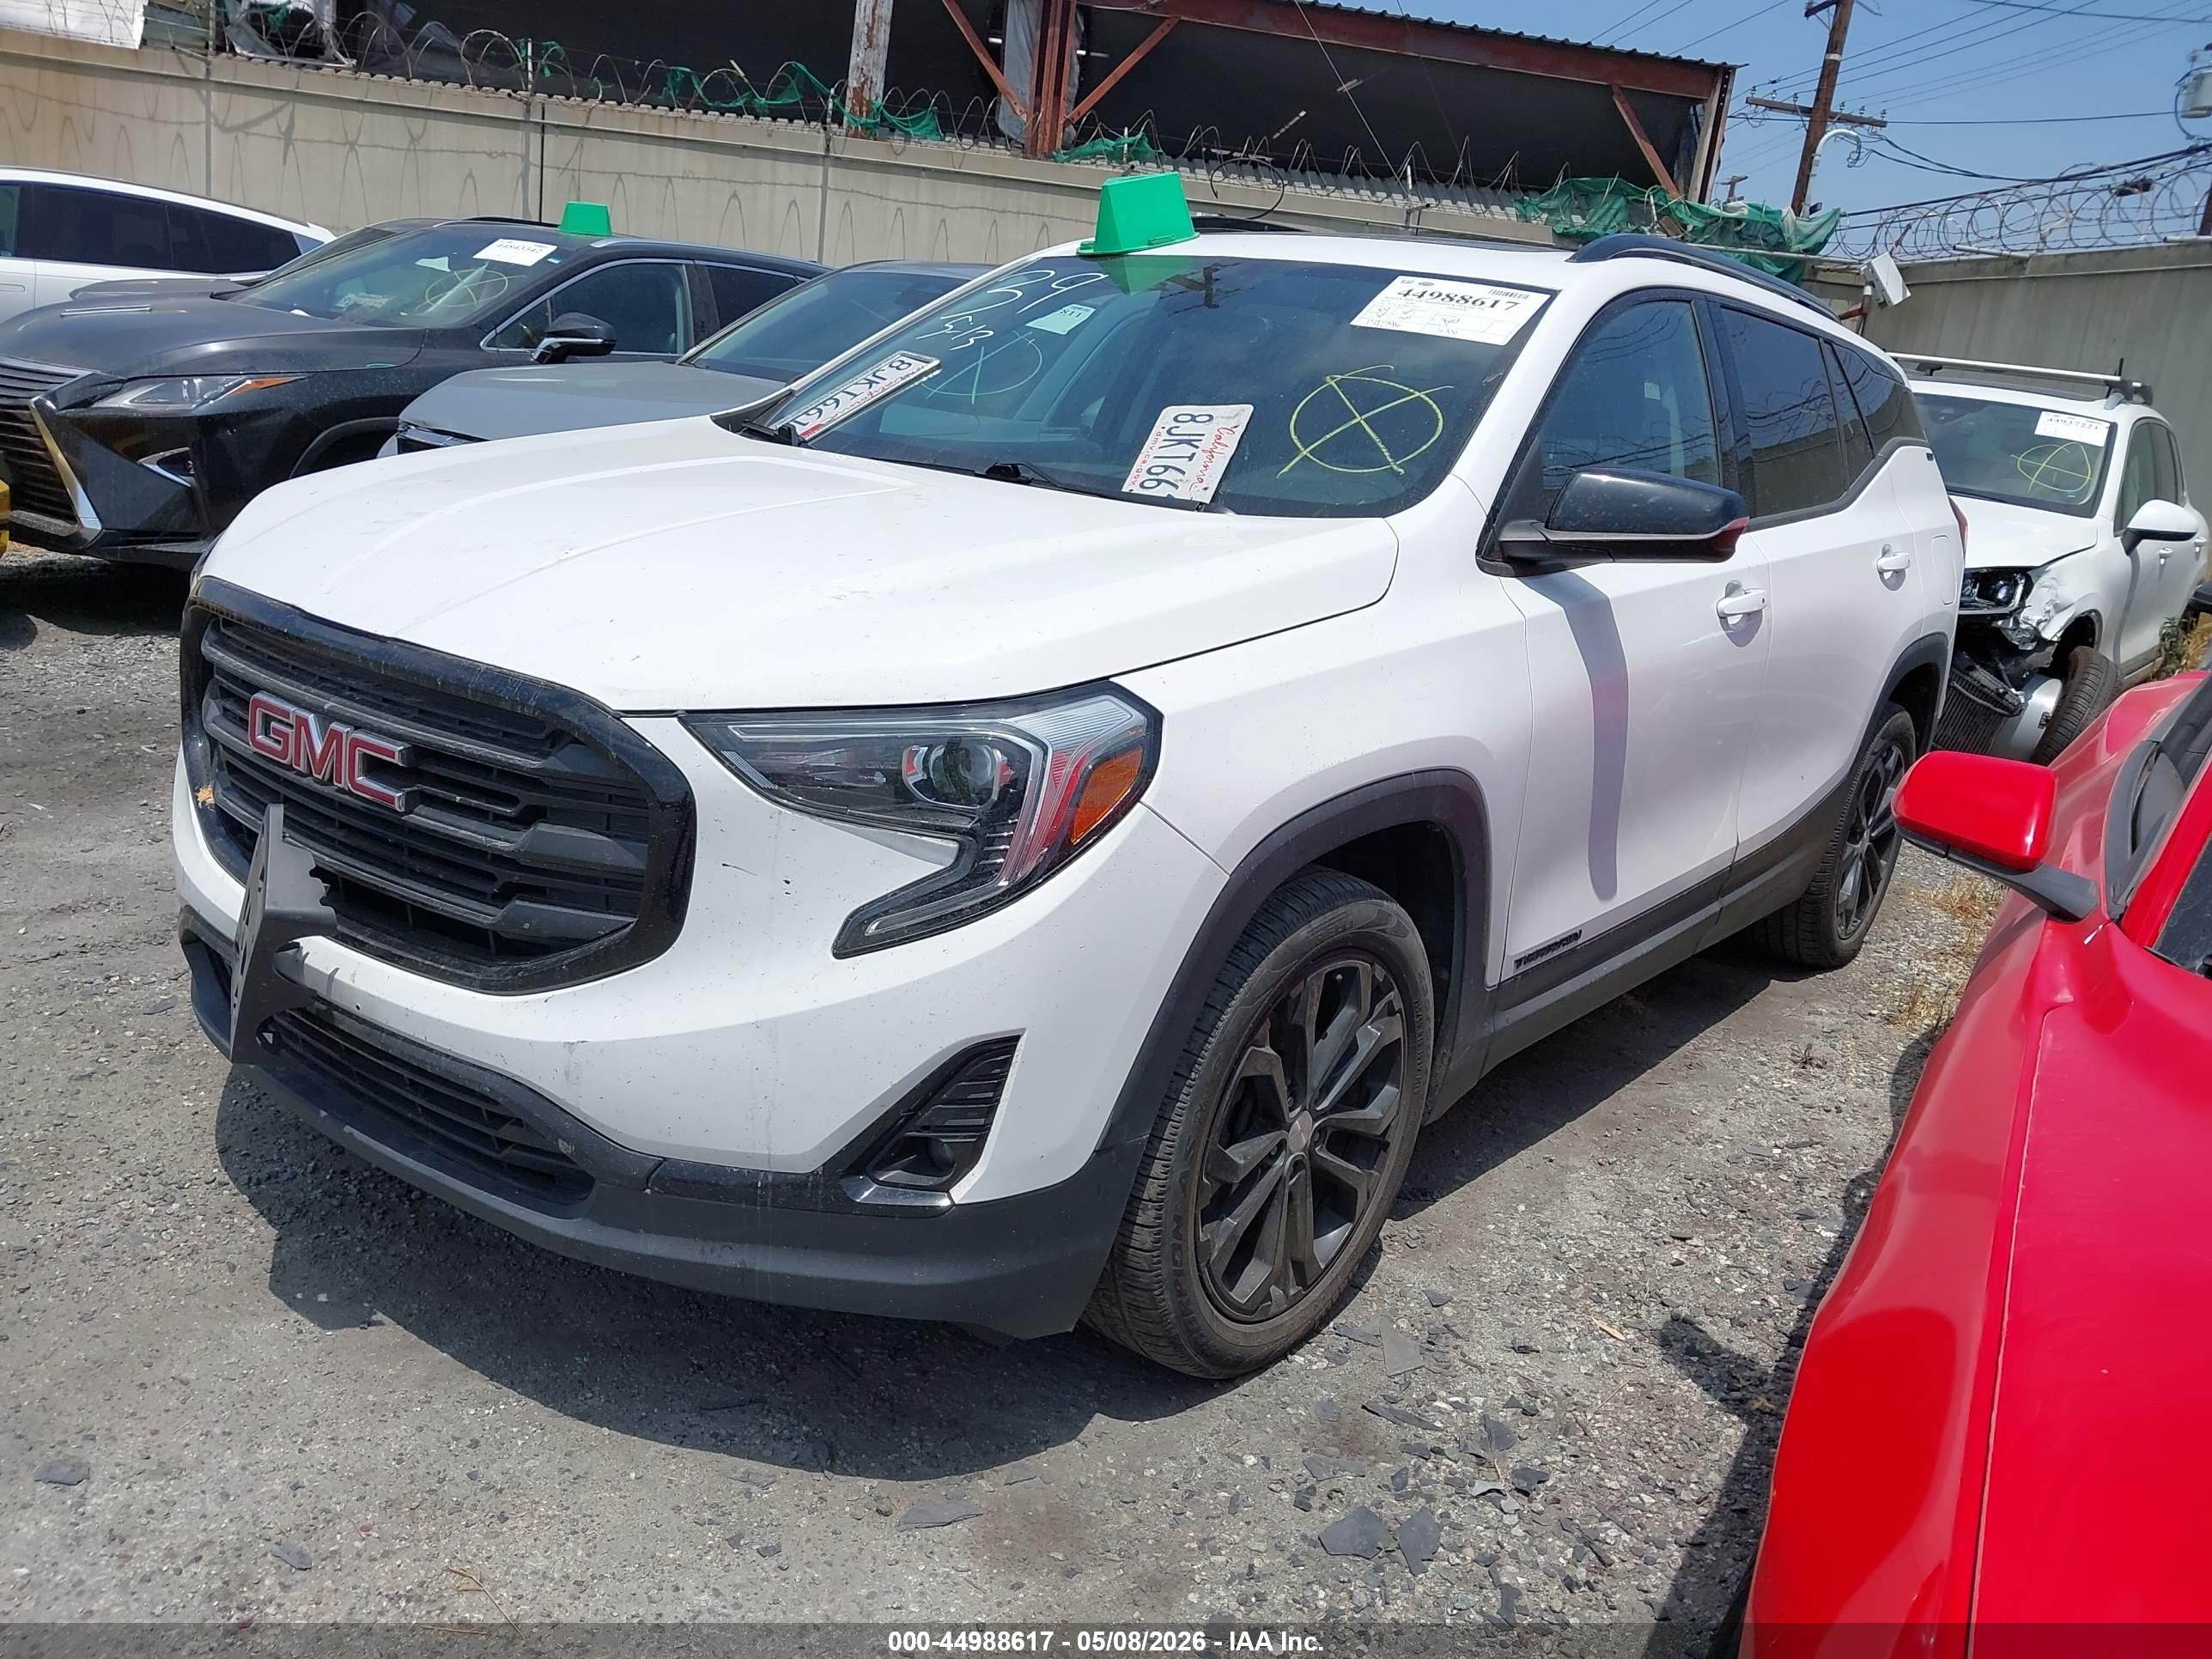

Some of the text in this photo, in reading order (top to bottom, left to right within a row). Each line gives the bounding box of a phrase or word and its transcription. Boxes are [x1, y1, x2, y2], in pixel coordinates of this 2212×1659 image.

[1396, 288, 1522, 311] 44988617
[789, 358, 912, 428] 8JKT661
[1128, 430, 1162, 486] dmv.ca.gov
[1139, 413, 1215, 498] 8JKT66
[1189, 426, 1237, 492] California
[248, 690, 410, 812] GMC
